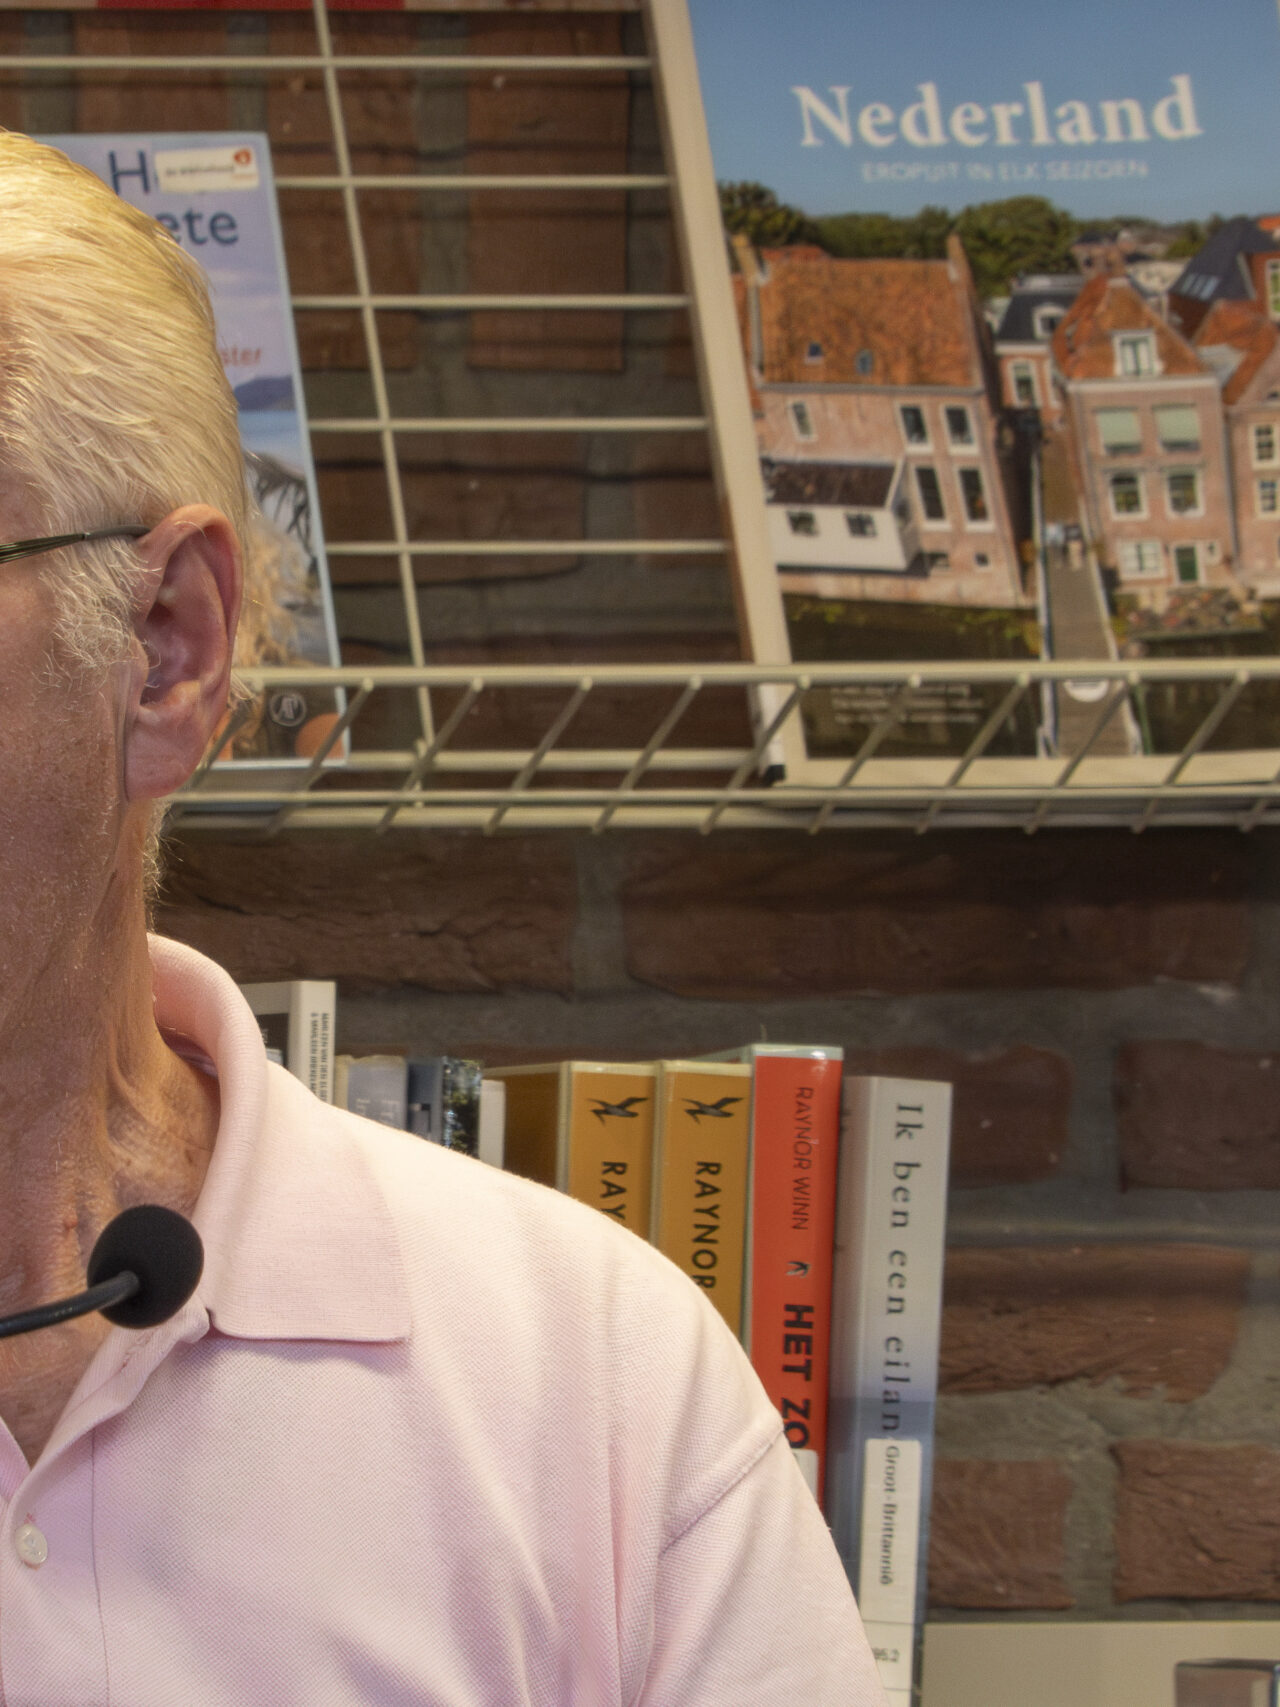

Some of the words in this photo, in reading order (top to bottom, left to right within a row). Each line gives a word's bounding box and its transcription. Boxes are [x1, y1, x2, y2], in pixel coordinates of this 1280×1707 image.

[791, 73, 1204, 148] Nederland
[792, 1085, 814, 1171] RAYNOR
[895, 1104, 924, 1141] Ik
[791, 1176, 811, 1231] WINN
[890, 1161, 922, 1229] ben
[886, 1248, 908, 1316] een
[782, 1303, 815, 1382] HET
